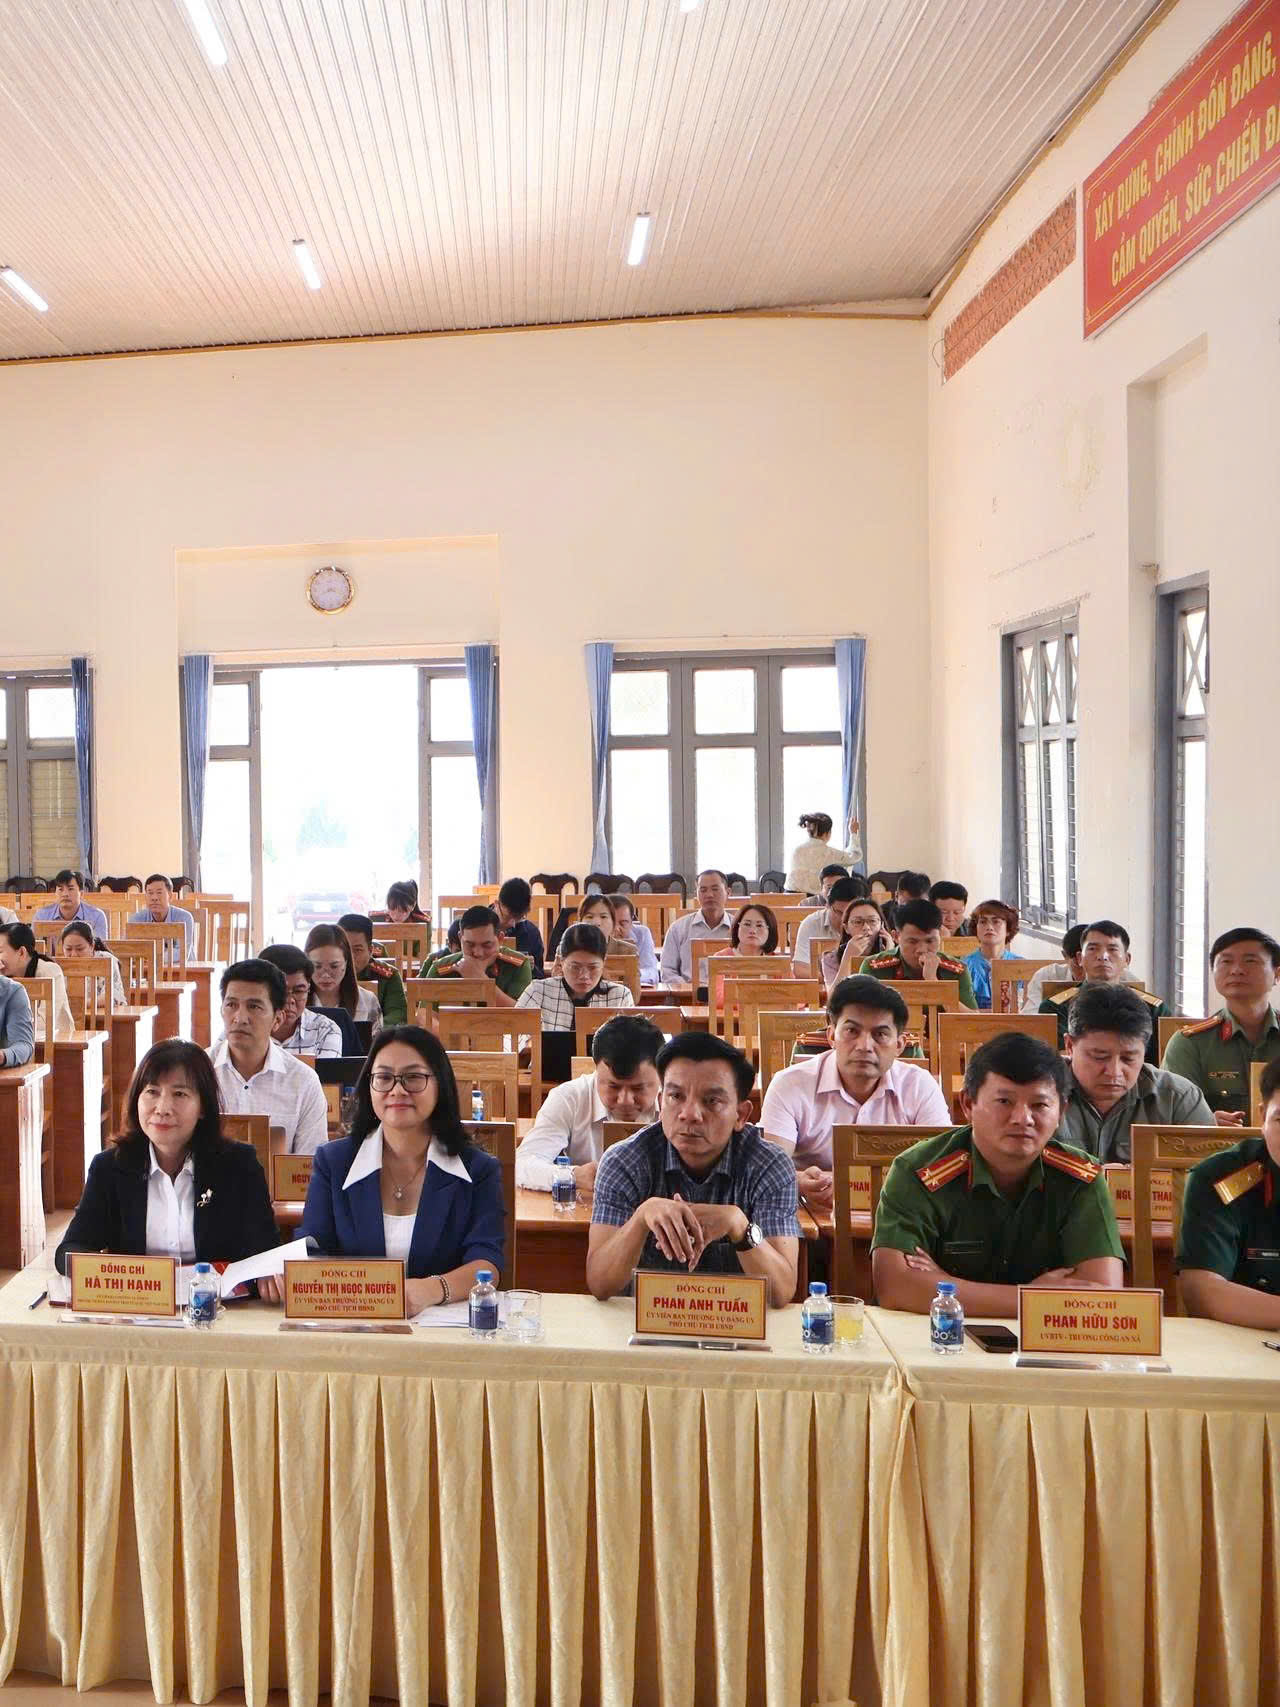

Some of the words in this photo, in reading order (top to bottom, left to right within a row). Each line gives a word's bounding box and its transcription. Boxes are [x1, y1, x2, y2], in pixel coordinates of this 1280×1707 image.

[1118, 158, 1152, 220] DỰNG,
[1230, 31, 1277, 108] ĐẢNG,
[1185, 163, 1212, 223] SỨC
[1216, 108, 1261, 194] CHIẾN
[100, 1263, 126, 1274] ĐỒNG
[128, 1264, 145, 1275] CHÍ
[104, 1278, 123, 1292] THỊ
[127, 1279, 161, 1293] HẠNH
[326, 1282, 339, 1297] THỊ
[341, 1282, 363, 1297] NGỌC
[653, 1297, 685, 1309] PHAN
[689, 1299, 713, 1311] ANH
[717, 1297, 748, 1313] TUẤN
[1064, 1298, 1095, 1309] ĐỒNG
[1097, 1299, 1117, 1310] CHÍ
[1043, 1314, 1077, 1328] PHAN
[1082, 1313, 1108, 1329] HỮU
[1112, 1315, 1137, 1330] SƠN
